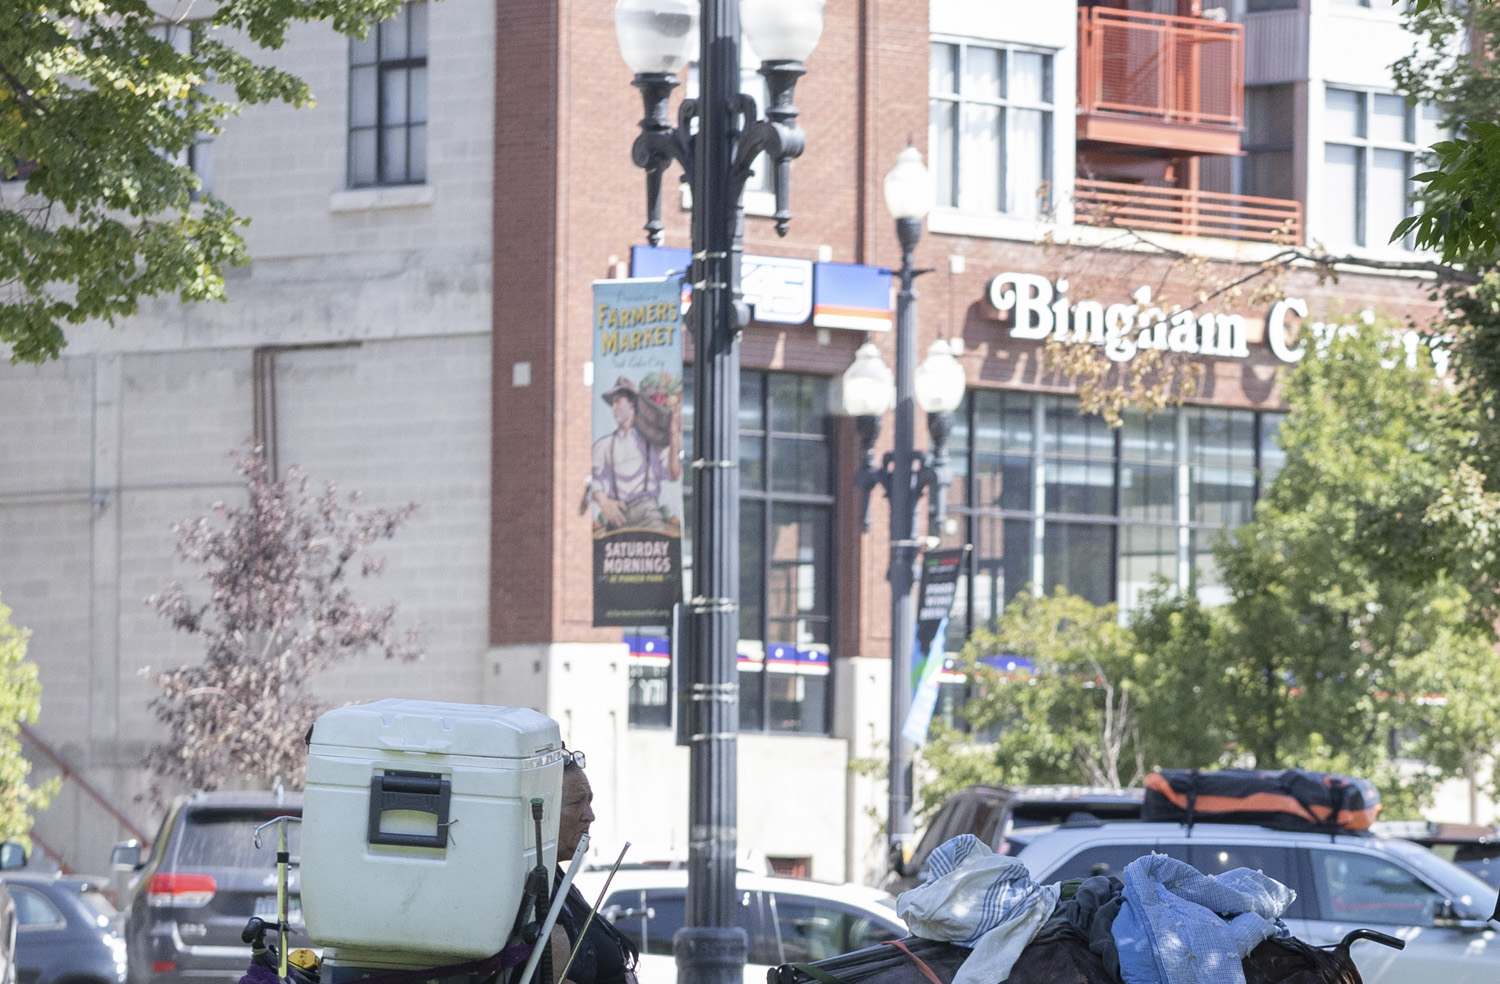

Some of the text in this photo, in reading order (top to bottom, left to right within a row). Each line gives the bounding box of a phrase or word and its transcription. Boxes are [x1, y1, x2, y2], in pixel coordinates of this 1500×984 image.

[597, 302, 679, 328] FARMERS
[990, 271, 1250, 362] Bingham
[601, 325, 674, 355] MARKET
[605, 541, 669, 557] SATURDAY
[603, 557, 671, 574] MORNINGS
